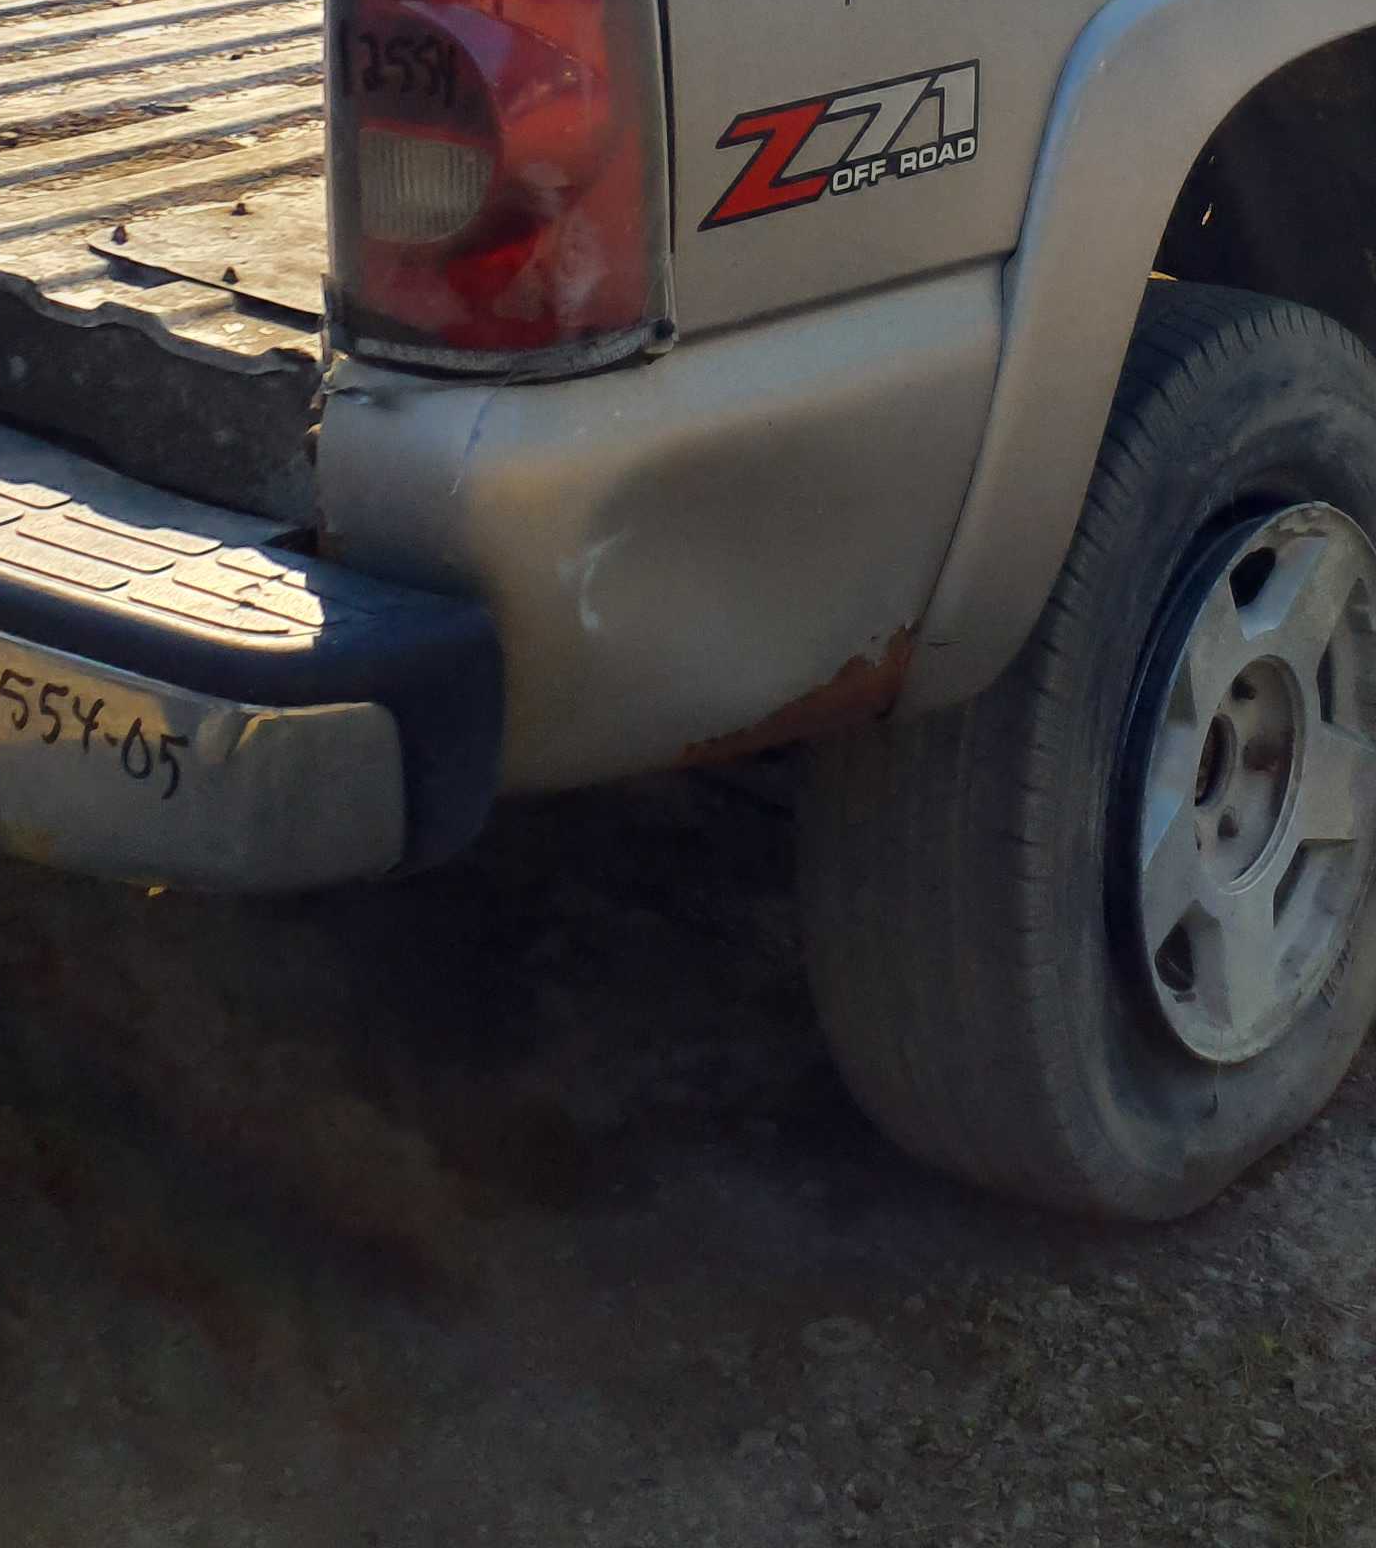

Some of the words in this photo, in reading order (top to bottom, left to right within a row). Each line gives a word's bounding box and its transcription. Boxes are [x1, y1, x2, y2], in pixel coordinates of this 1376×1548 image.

[697, 59, 980, 232] Z71
[830, 160, 887, 195] OFF
[899, 136, 977, 175] ROAD
